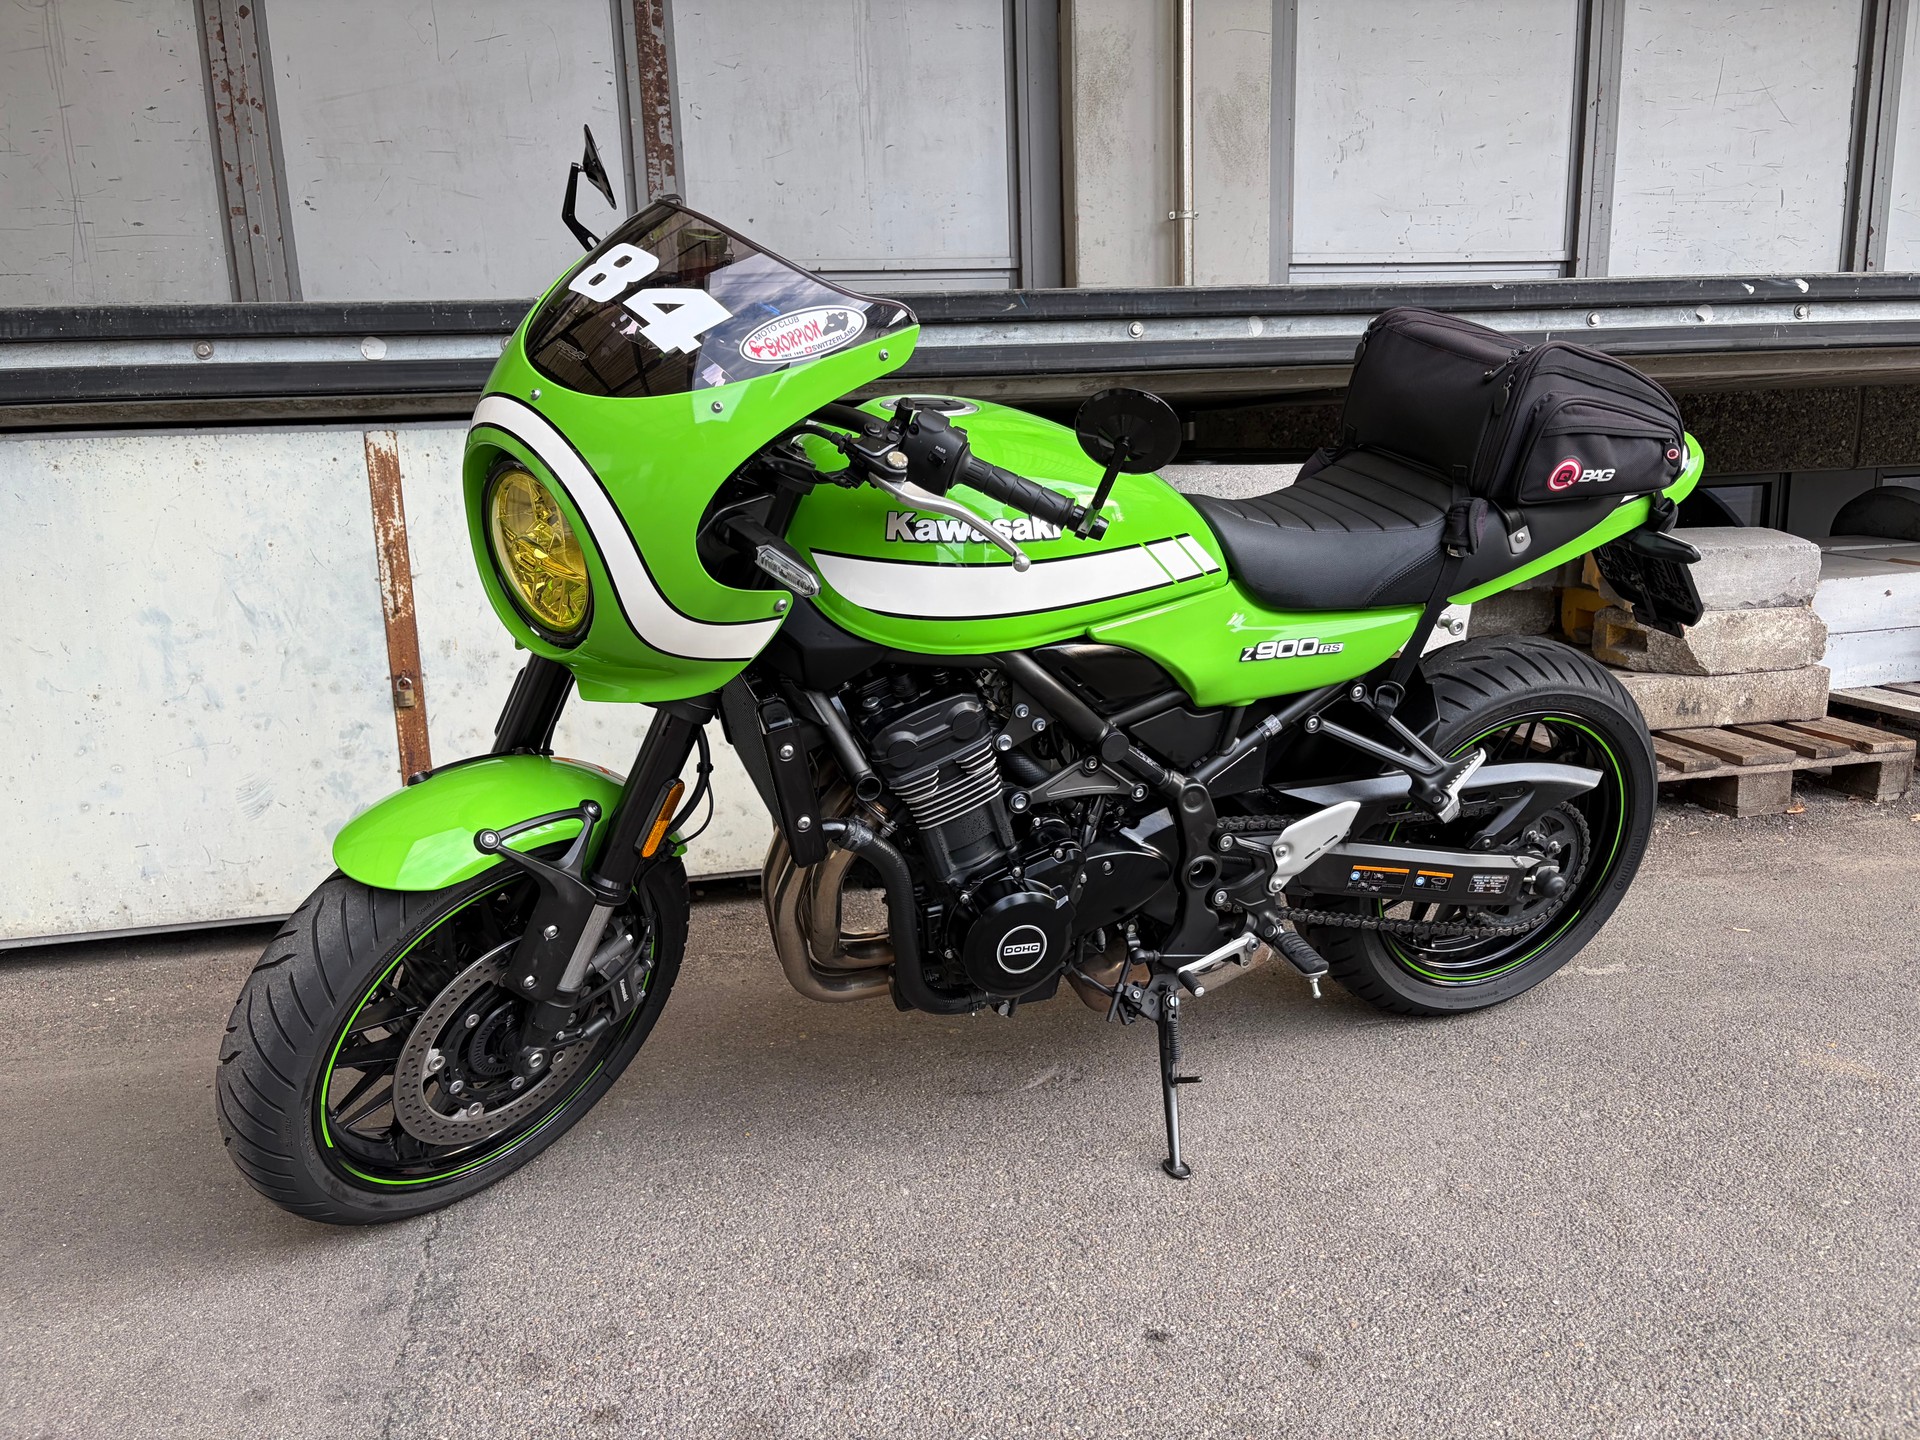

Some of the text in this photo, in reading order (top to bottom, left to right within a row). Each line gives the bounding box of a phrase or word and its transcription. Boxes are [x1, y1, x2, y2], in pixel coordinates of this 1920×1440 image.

[754, 316, 800, 342] MOTO CLUB
[764, 319, 823, 357] SKORPION
[811, 326, 857, 351] SWITZERLAND
[1579, 469, 1615, 482] BAG
[1614, 834, 1643, 890] Continental
[1005, 944, 1039, 955] DOHC
